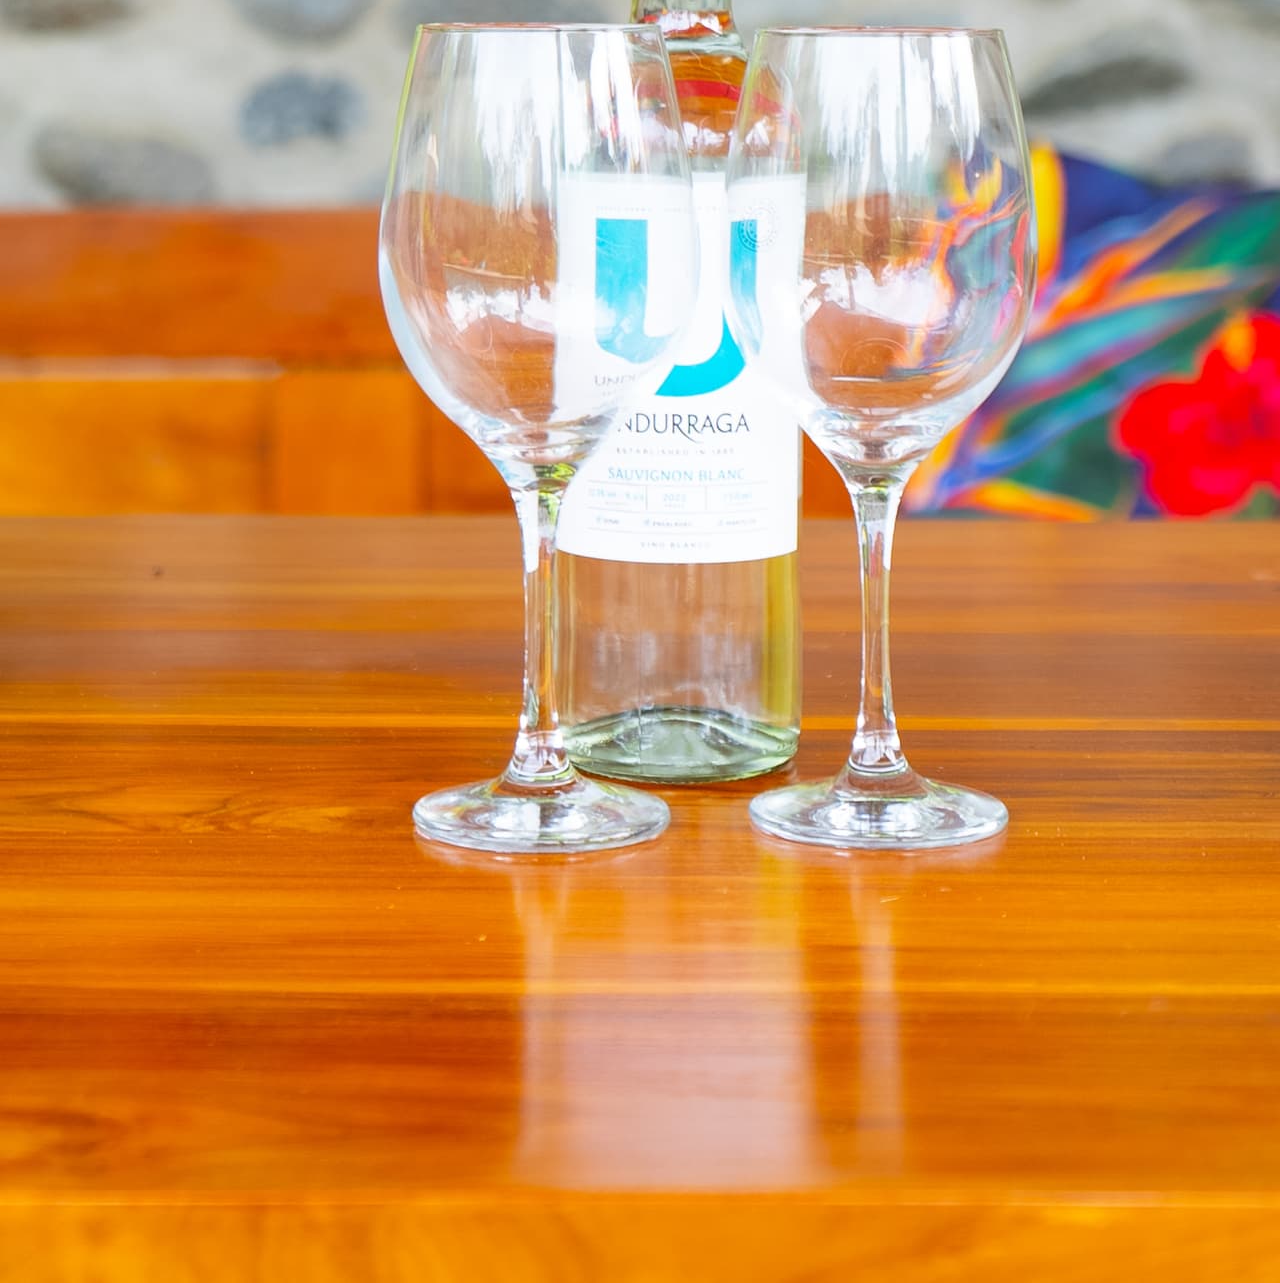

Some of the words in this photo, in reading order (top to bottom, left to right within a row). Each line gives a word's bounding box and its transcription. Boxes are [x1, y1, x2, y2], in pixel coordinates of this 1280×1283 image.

[618, 412, 750, 443] NDURRAGA
[608, 467, 694, 482] SAUVIGNON
[699, 467, 745, 481] BLANC
